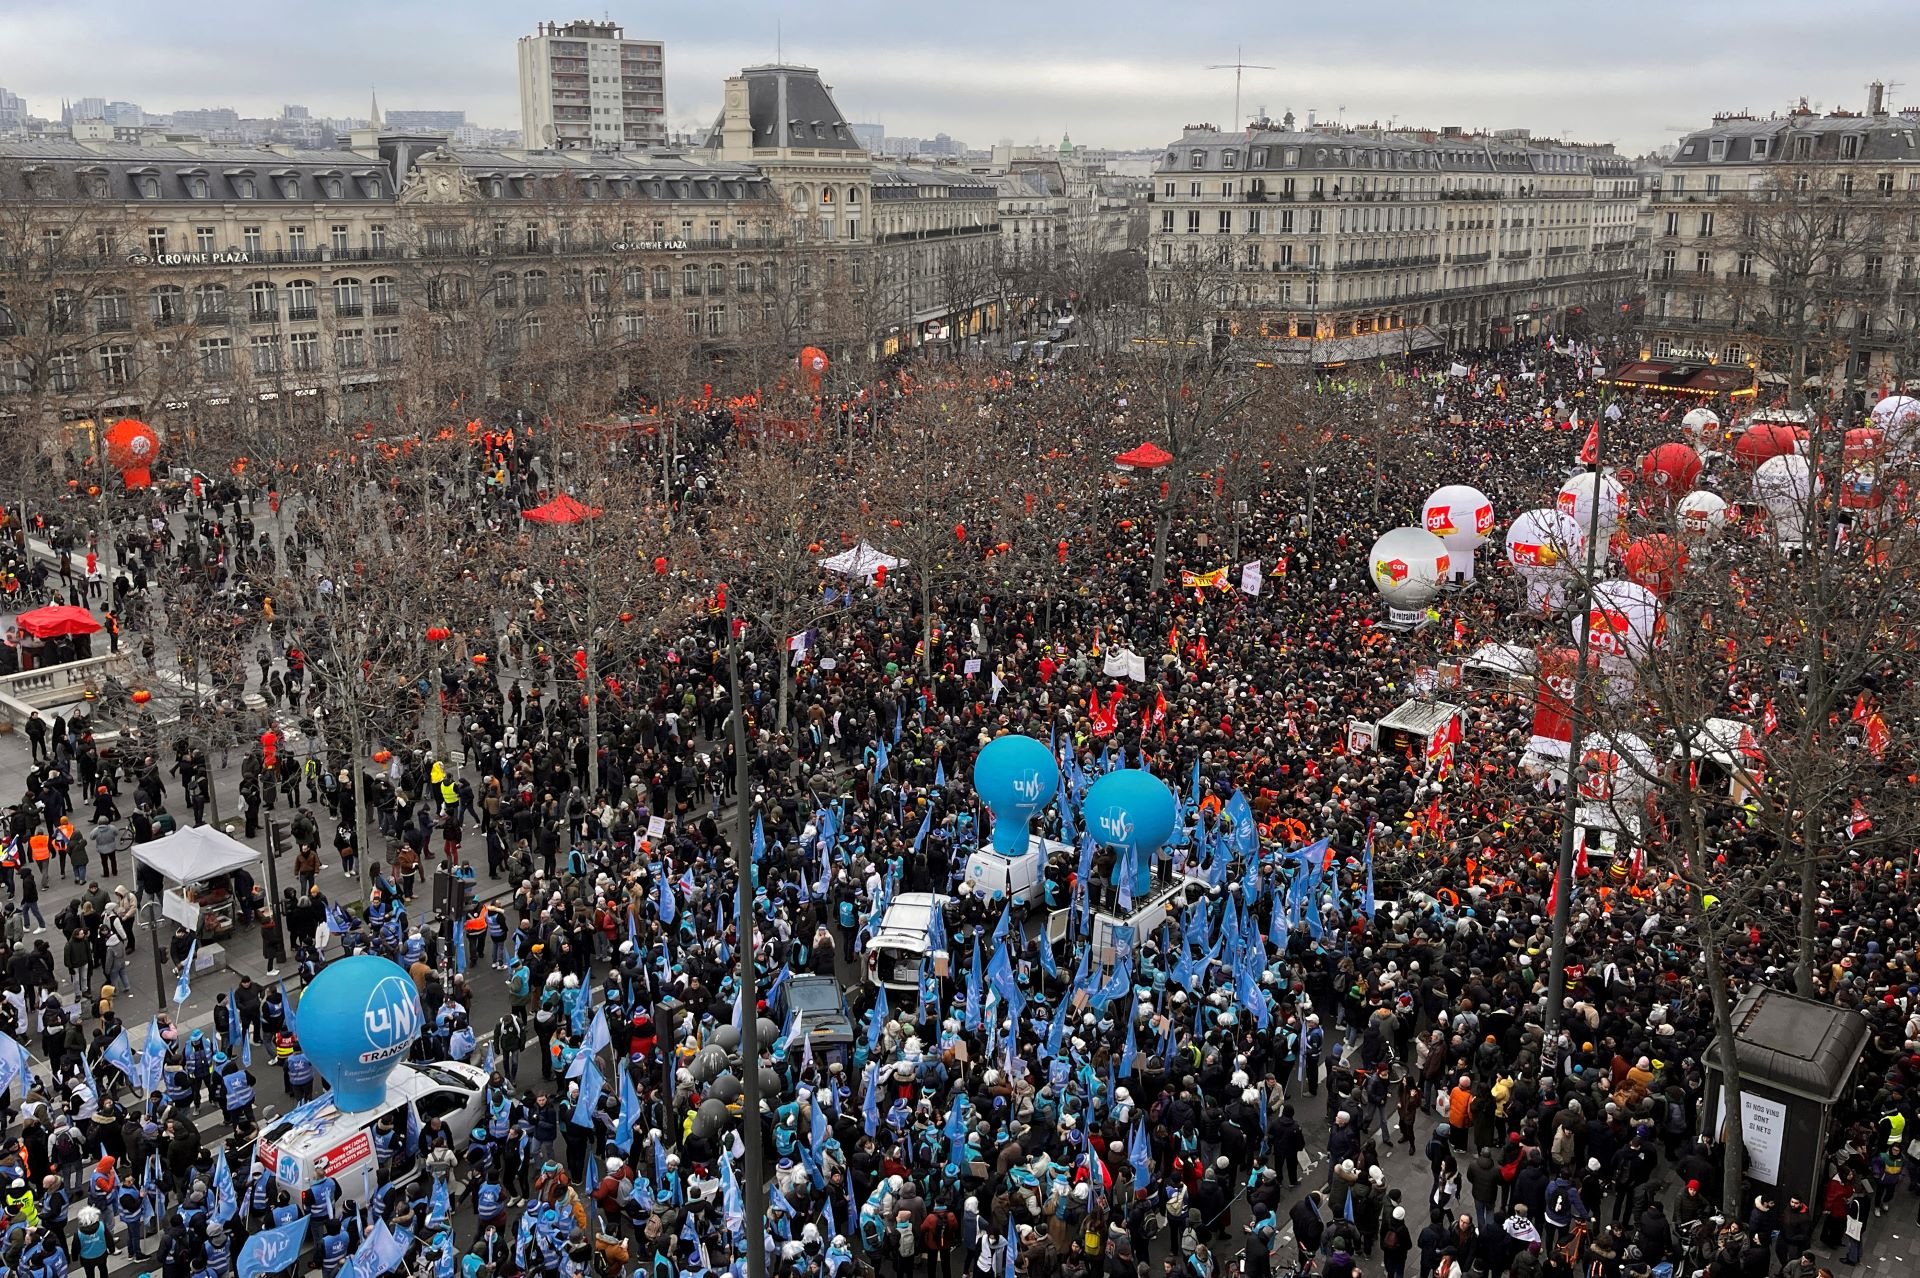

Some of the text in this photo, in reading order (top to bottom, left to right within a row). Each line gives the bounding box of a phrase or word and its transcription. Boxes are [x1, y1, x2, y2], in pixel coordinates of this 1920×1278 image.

[664, 240, 687, 249] PLAZA
[157, 252, 249, 265] CROWNE PLAZA
[1670, 348, 1694, 357] PIZZA
[1427, 512, 1446, 529] cgt
[362, 1038, 412, 1062] TRANSP
[1745, 1101, 1780, 1118] SI NOS VINS
[1753, 1113, 1770, 1124] SONT
[1748, 1122, 1772, 1135] SI NETS
